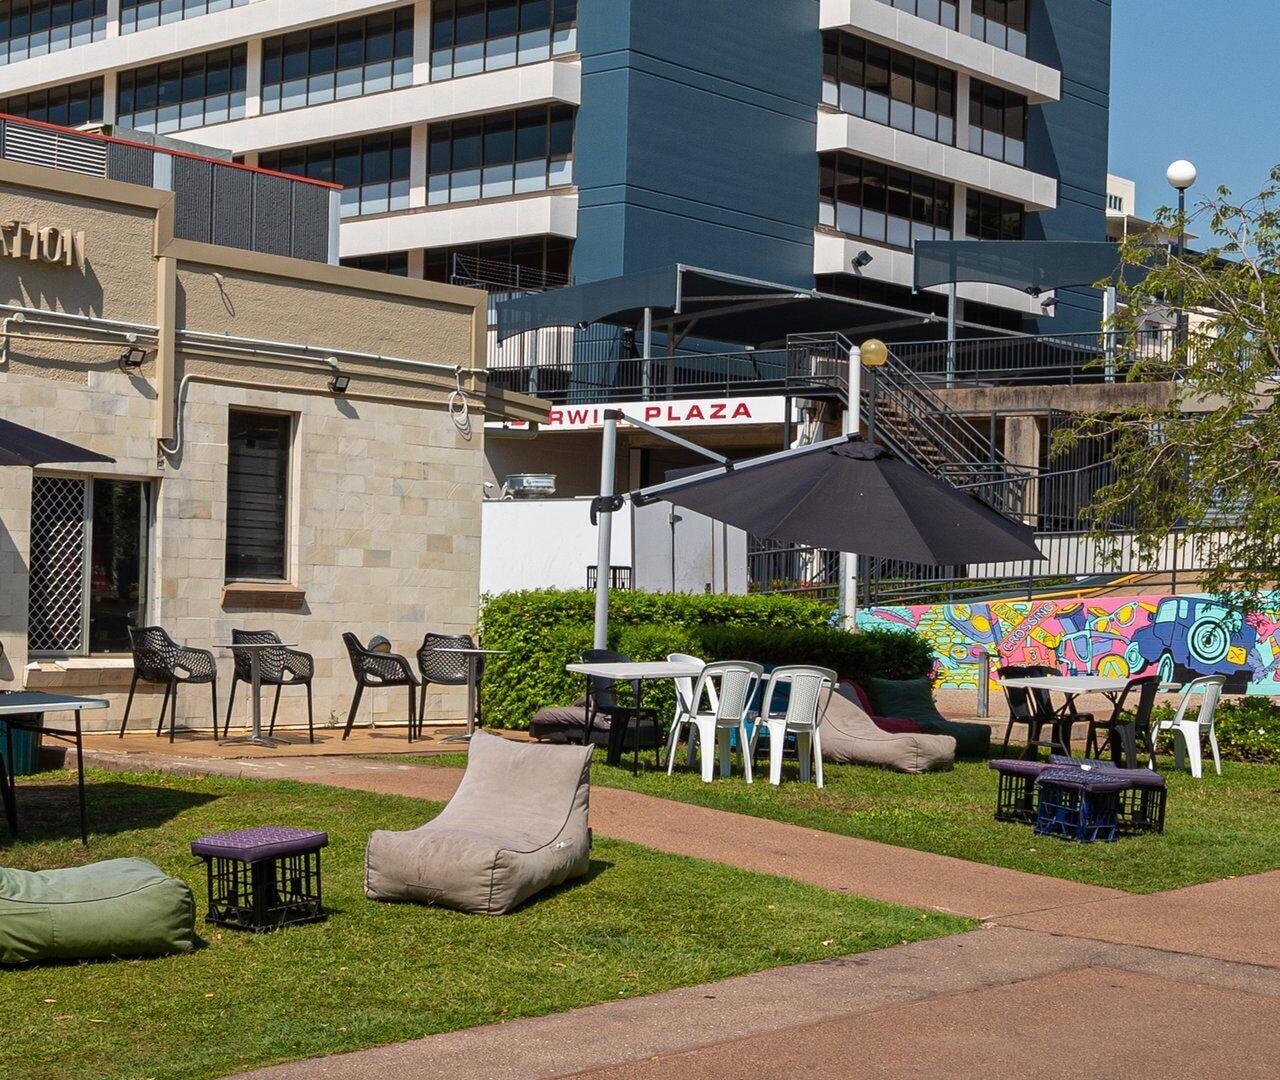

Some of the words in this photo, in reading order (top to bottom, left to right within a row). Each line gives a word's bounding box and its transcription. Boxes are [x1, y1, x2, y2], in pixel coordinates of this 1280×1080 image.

[645, 403, 752, 422] PLAZA
[1002, 601, 1055, 652] CROSSING
[1029, 649, 1038, 660] 3
